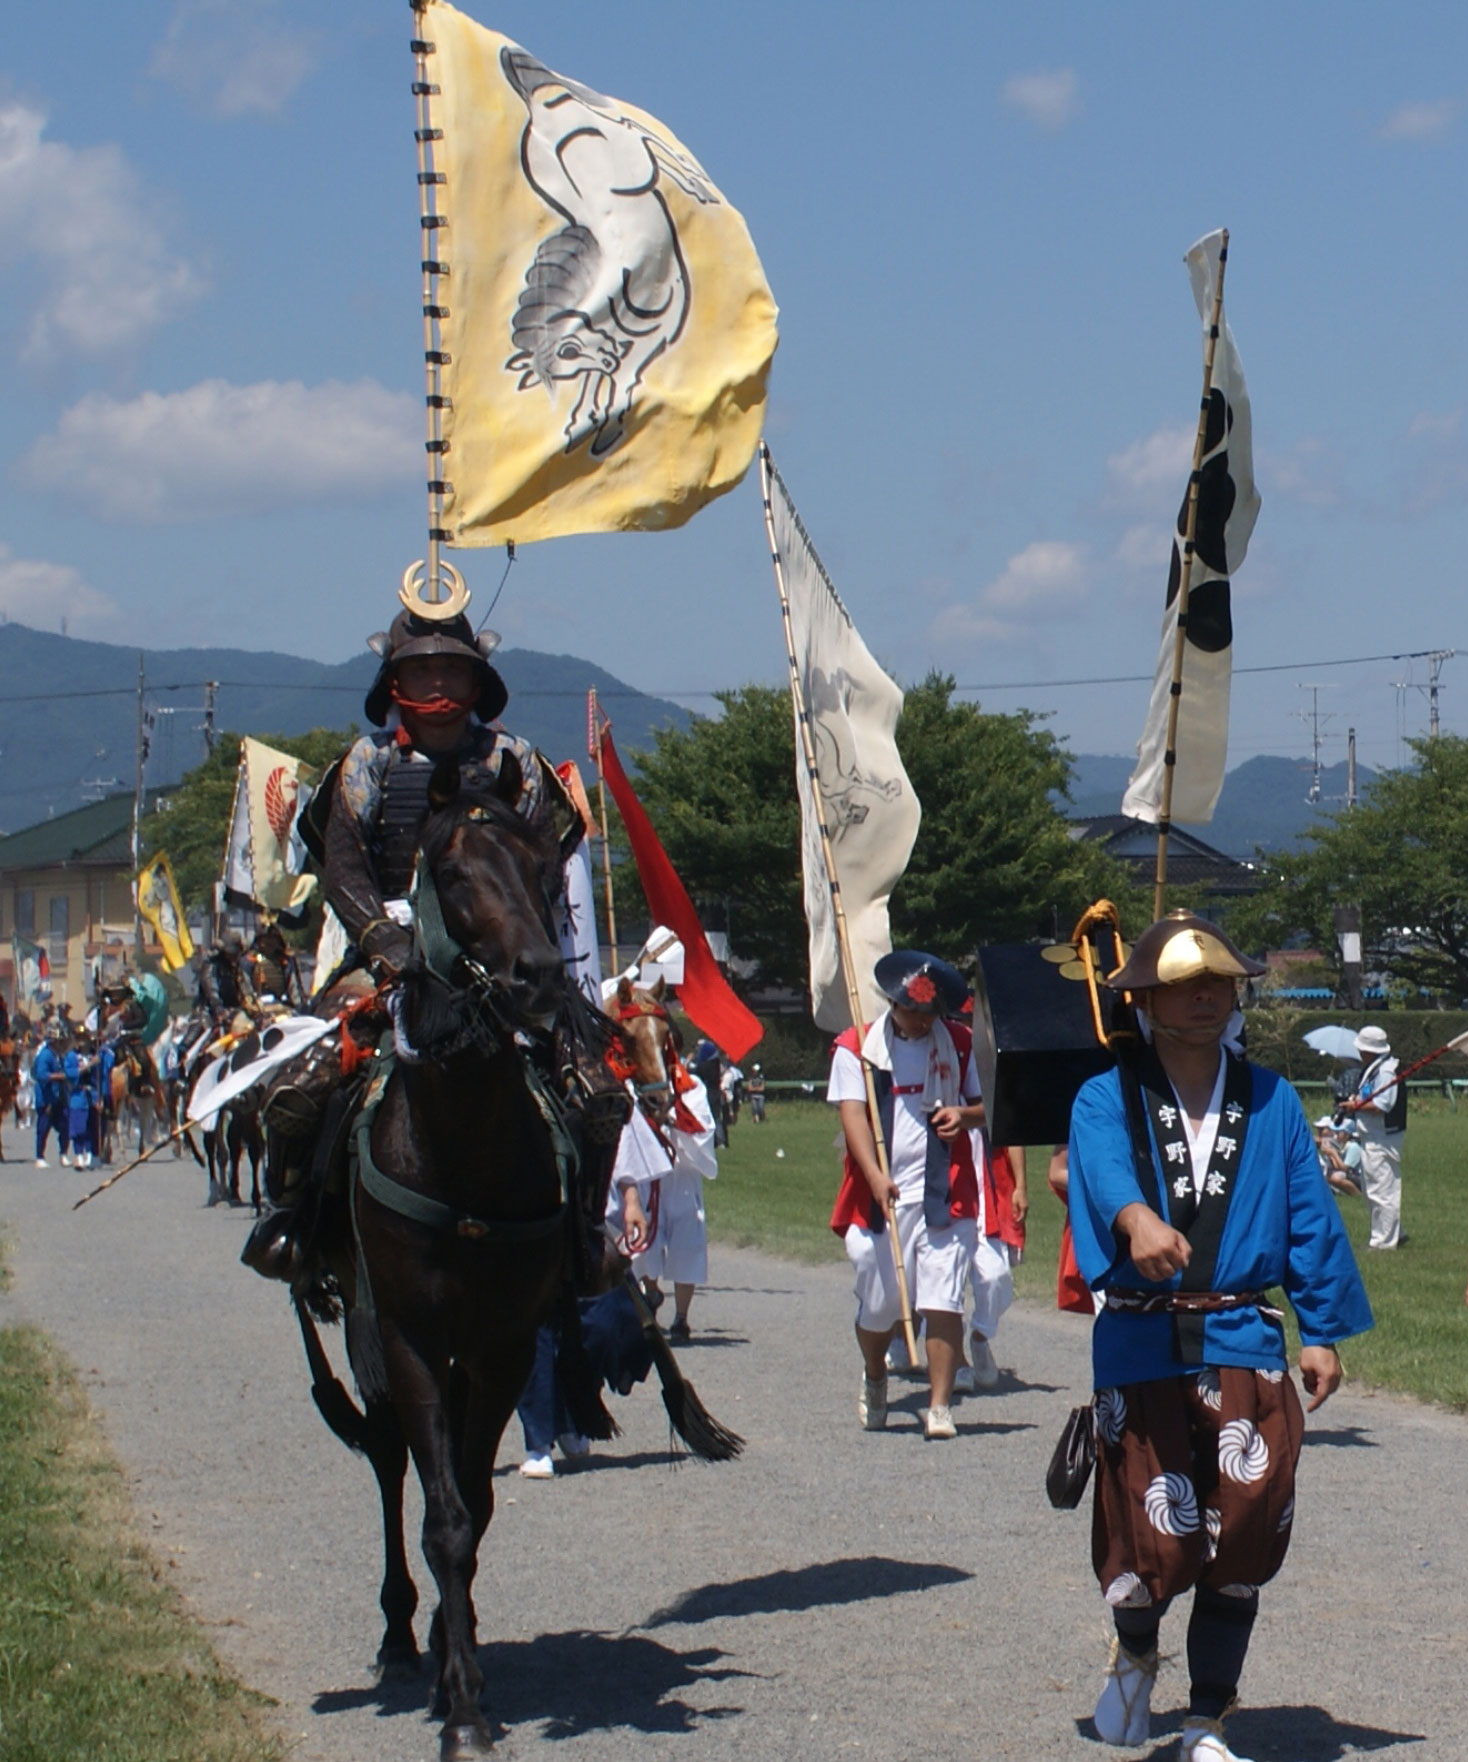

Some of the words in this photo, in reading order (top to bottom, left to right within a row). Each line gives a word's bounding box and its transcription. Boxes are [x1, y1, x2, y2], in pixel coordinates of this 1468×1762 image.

[1158, 1104, 1193, 1199] 宇野家
[1205, 1100, 1244, 1196] 宇野家
